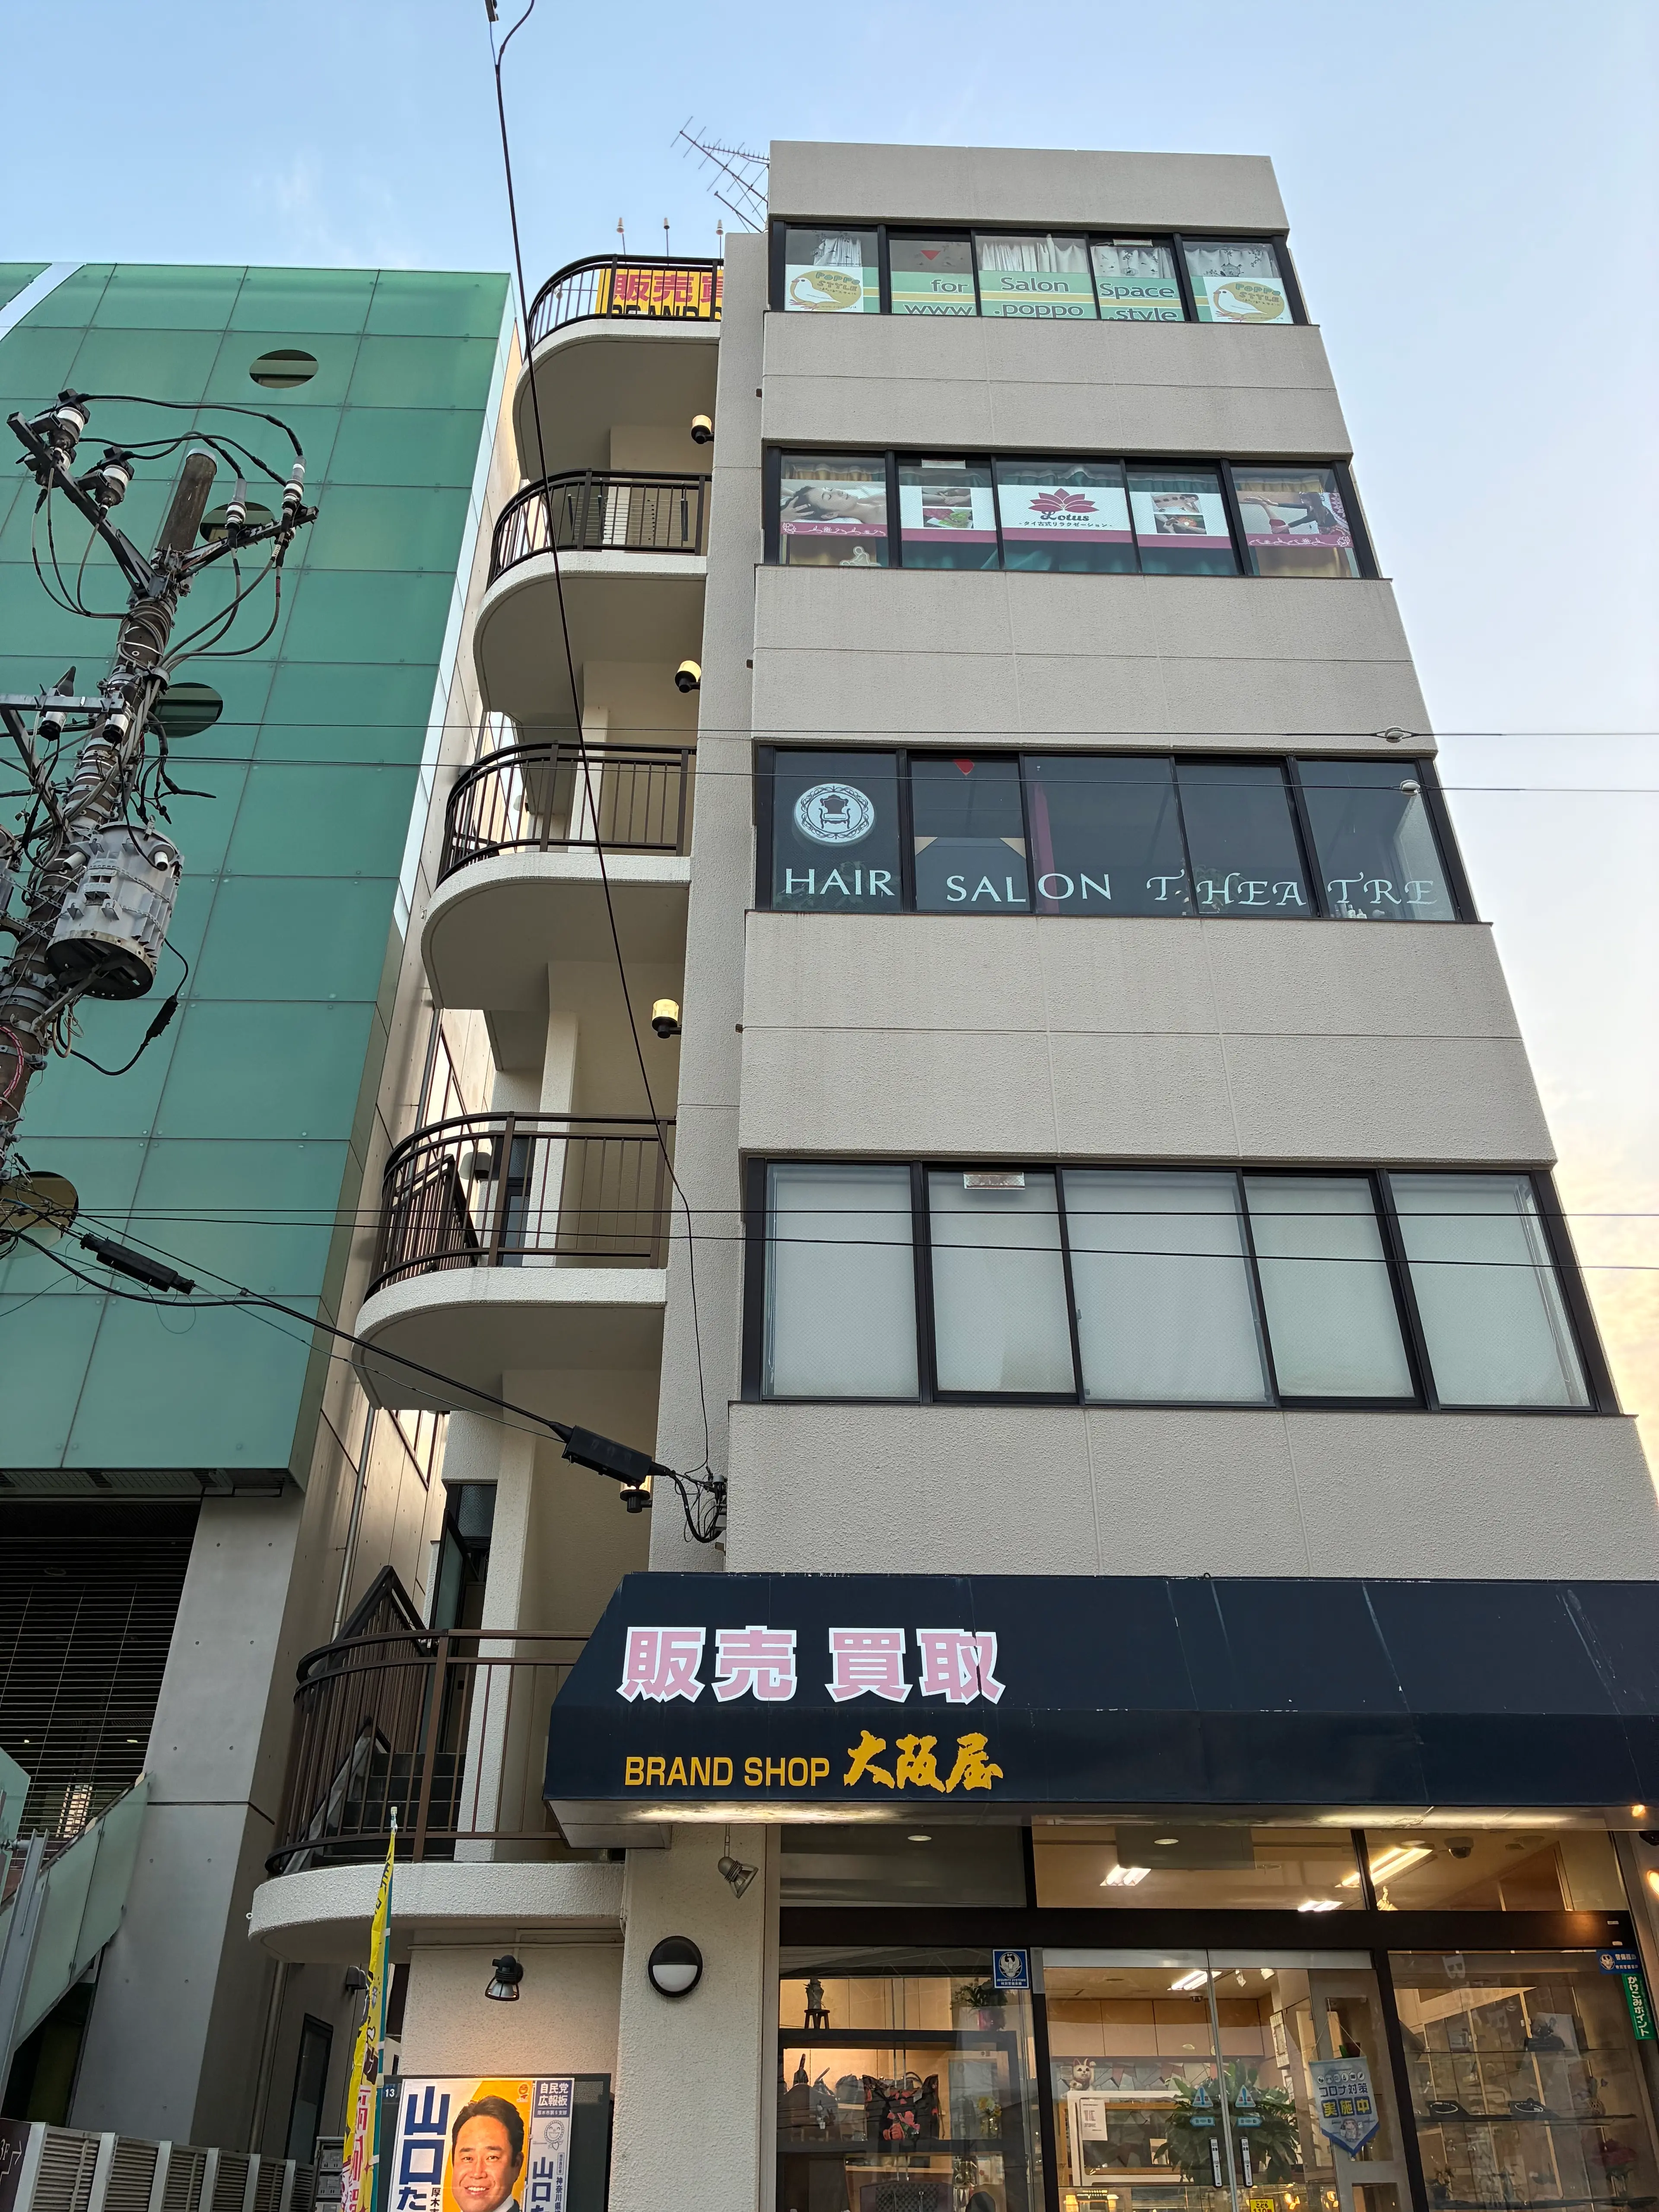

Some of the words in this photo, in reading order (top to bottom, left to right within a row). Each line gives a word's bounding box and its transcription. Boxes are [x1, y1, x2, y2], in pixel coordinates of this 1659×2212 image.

[816, 272, 860, 285] POPPO
[817, 280, 858, 291] STYLE
[931, 279, 969, 292] for
[1001, 277, 1069, 292] Salon
[1099, 282, 1175, 298] Space
[1236, 283, 1281, 296] POPPO
[1239, 292, 1279, 302] STYLE
[1040, 511, 1090, 521] Lotus
[785, 868, 895, 896] HAIR
[946, 873, 1112, 903] SALON
[1146, 868, 1438, 906] THEATRE
[624, 1756, 734, 1786] BRAND
[744, 1757, 830, 1787] SHOP
[844, 1730, 1004, 1793] 大阪屋
[1627, 1976, 1649, 2037] かけこみポイント
[385, 2088, 394, 2097] 13
[540, 2082, 569, 2094] 自民党
[1319, 2083, 1368, 2097] コロナ対策
[538, 2095, 568, 2106] 広報板
[1324, 2099, 1370, 2117] 実施中
[554, 2177, 563, 2212] 神奈川県
